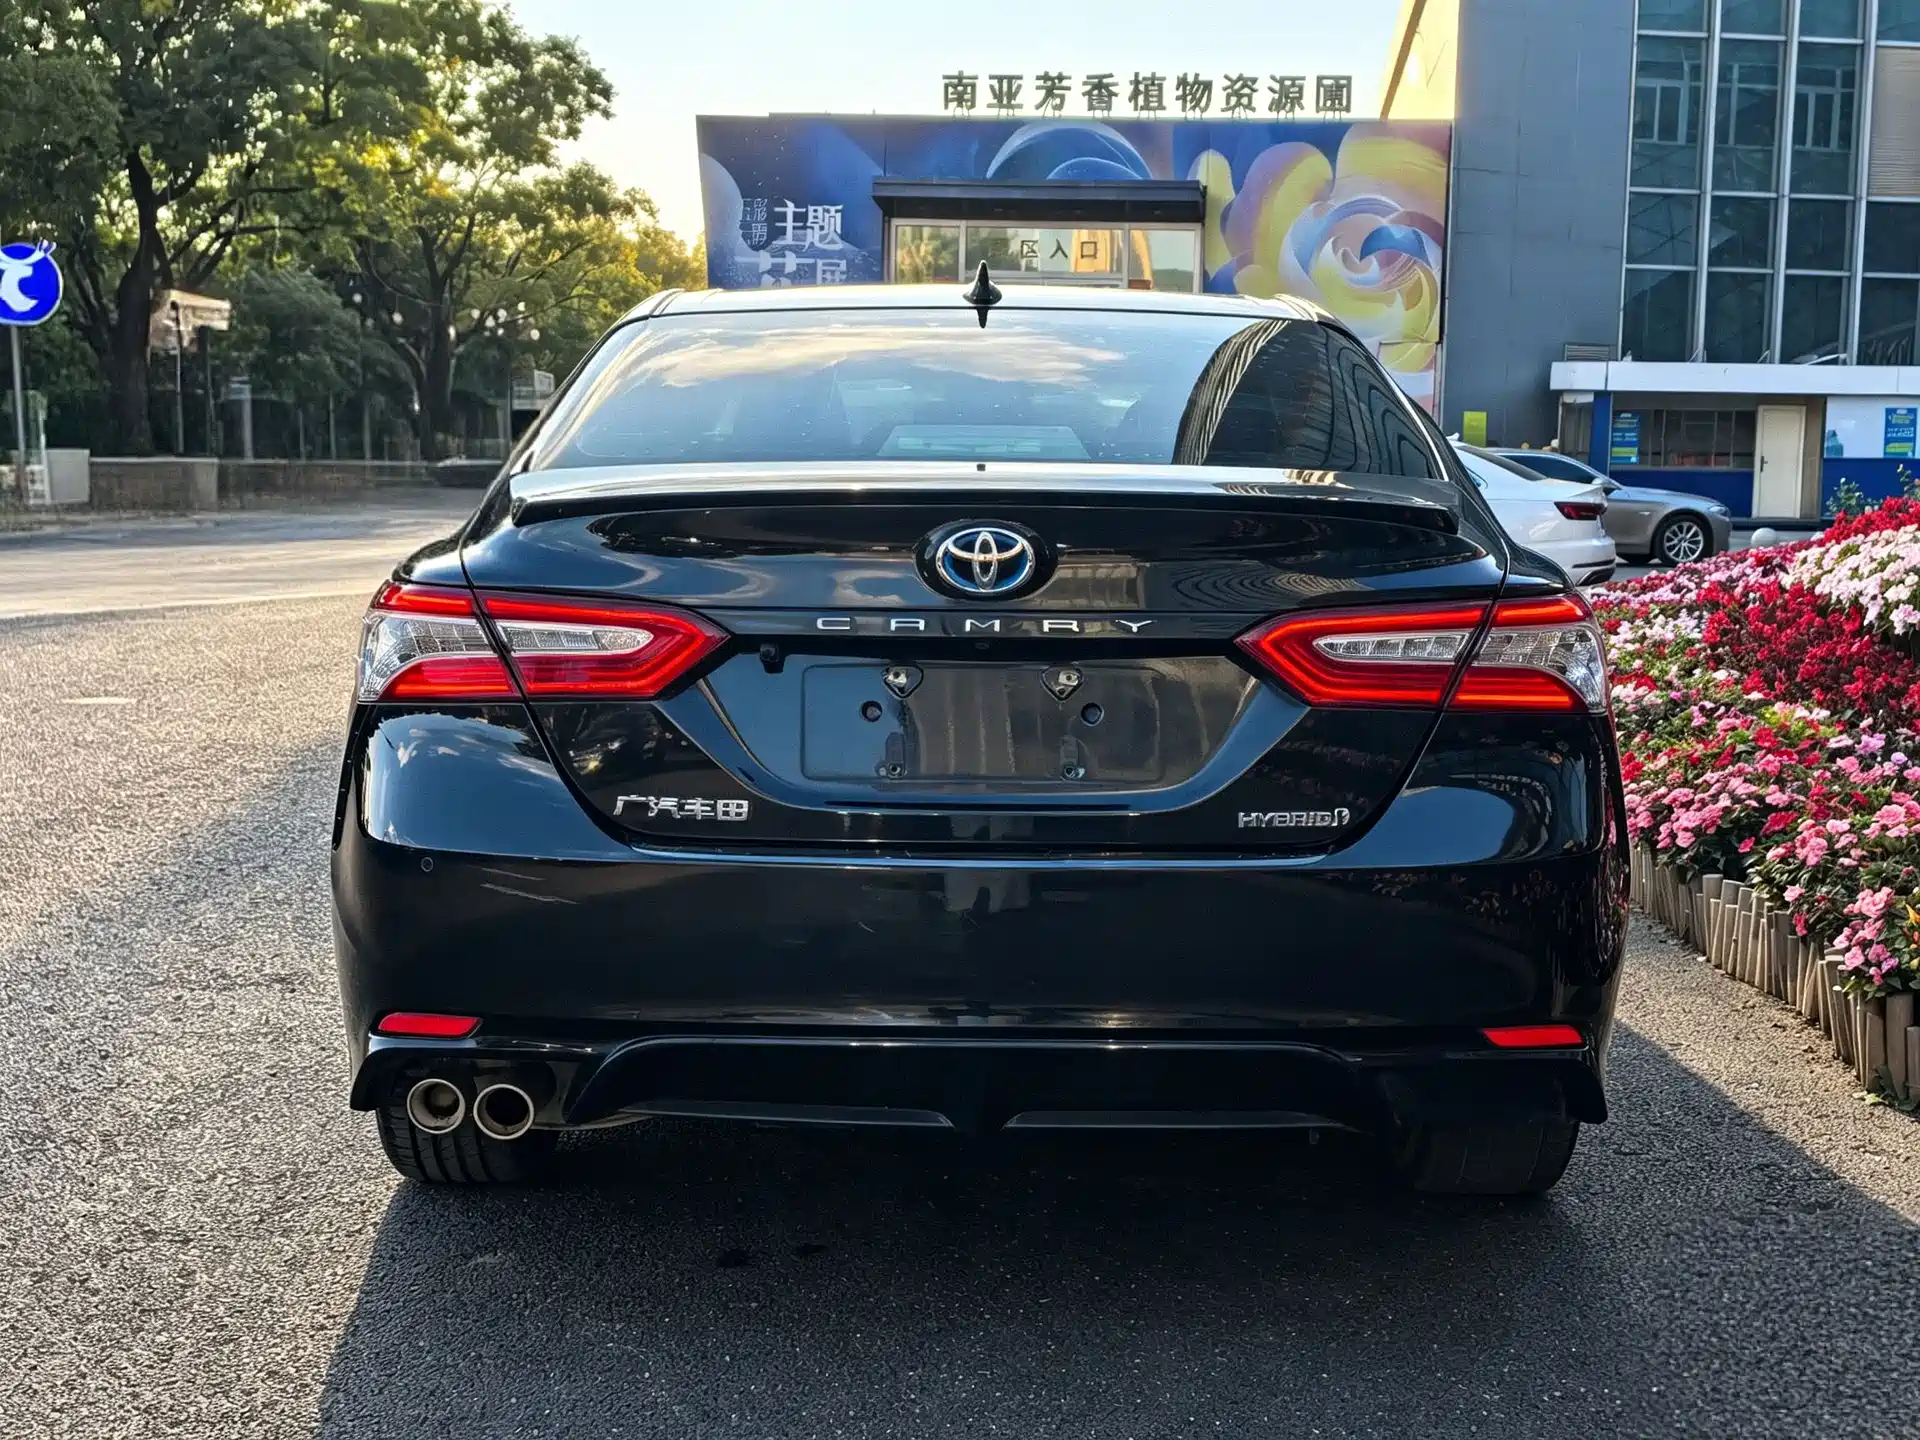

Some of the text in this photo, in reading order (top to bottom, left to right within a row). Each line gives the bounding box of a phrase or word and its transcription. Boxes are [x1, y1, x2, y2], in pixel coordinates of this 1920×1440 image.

[942, 71, 1353, 114] 南亚芳香植物资源圃
[772, 199, 844, 251] 主题
[816, 617, 1157, 633] CAMRY
[613, 795, 749, 821] 广汽丰田
[1238, 811, 1332, 828] HYBRID
